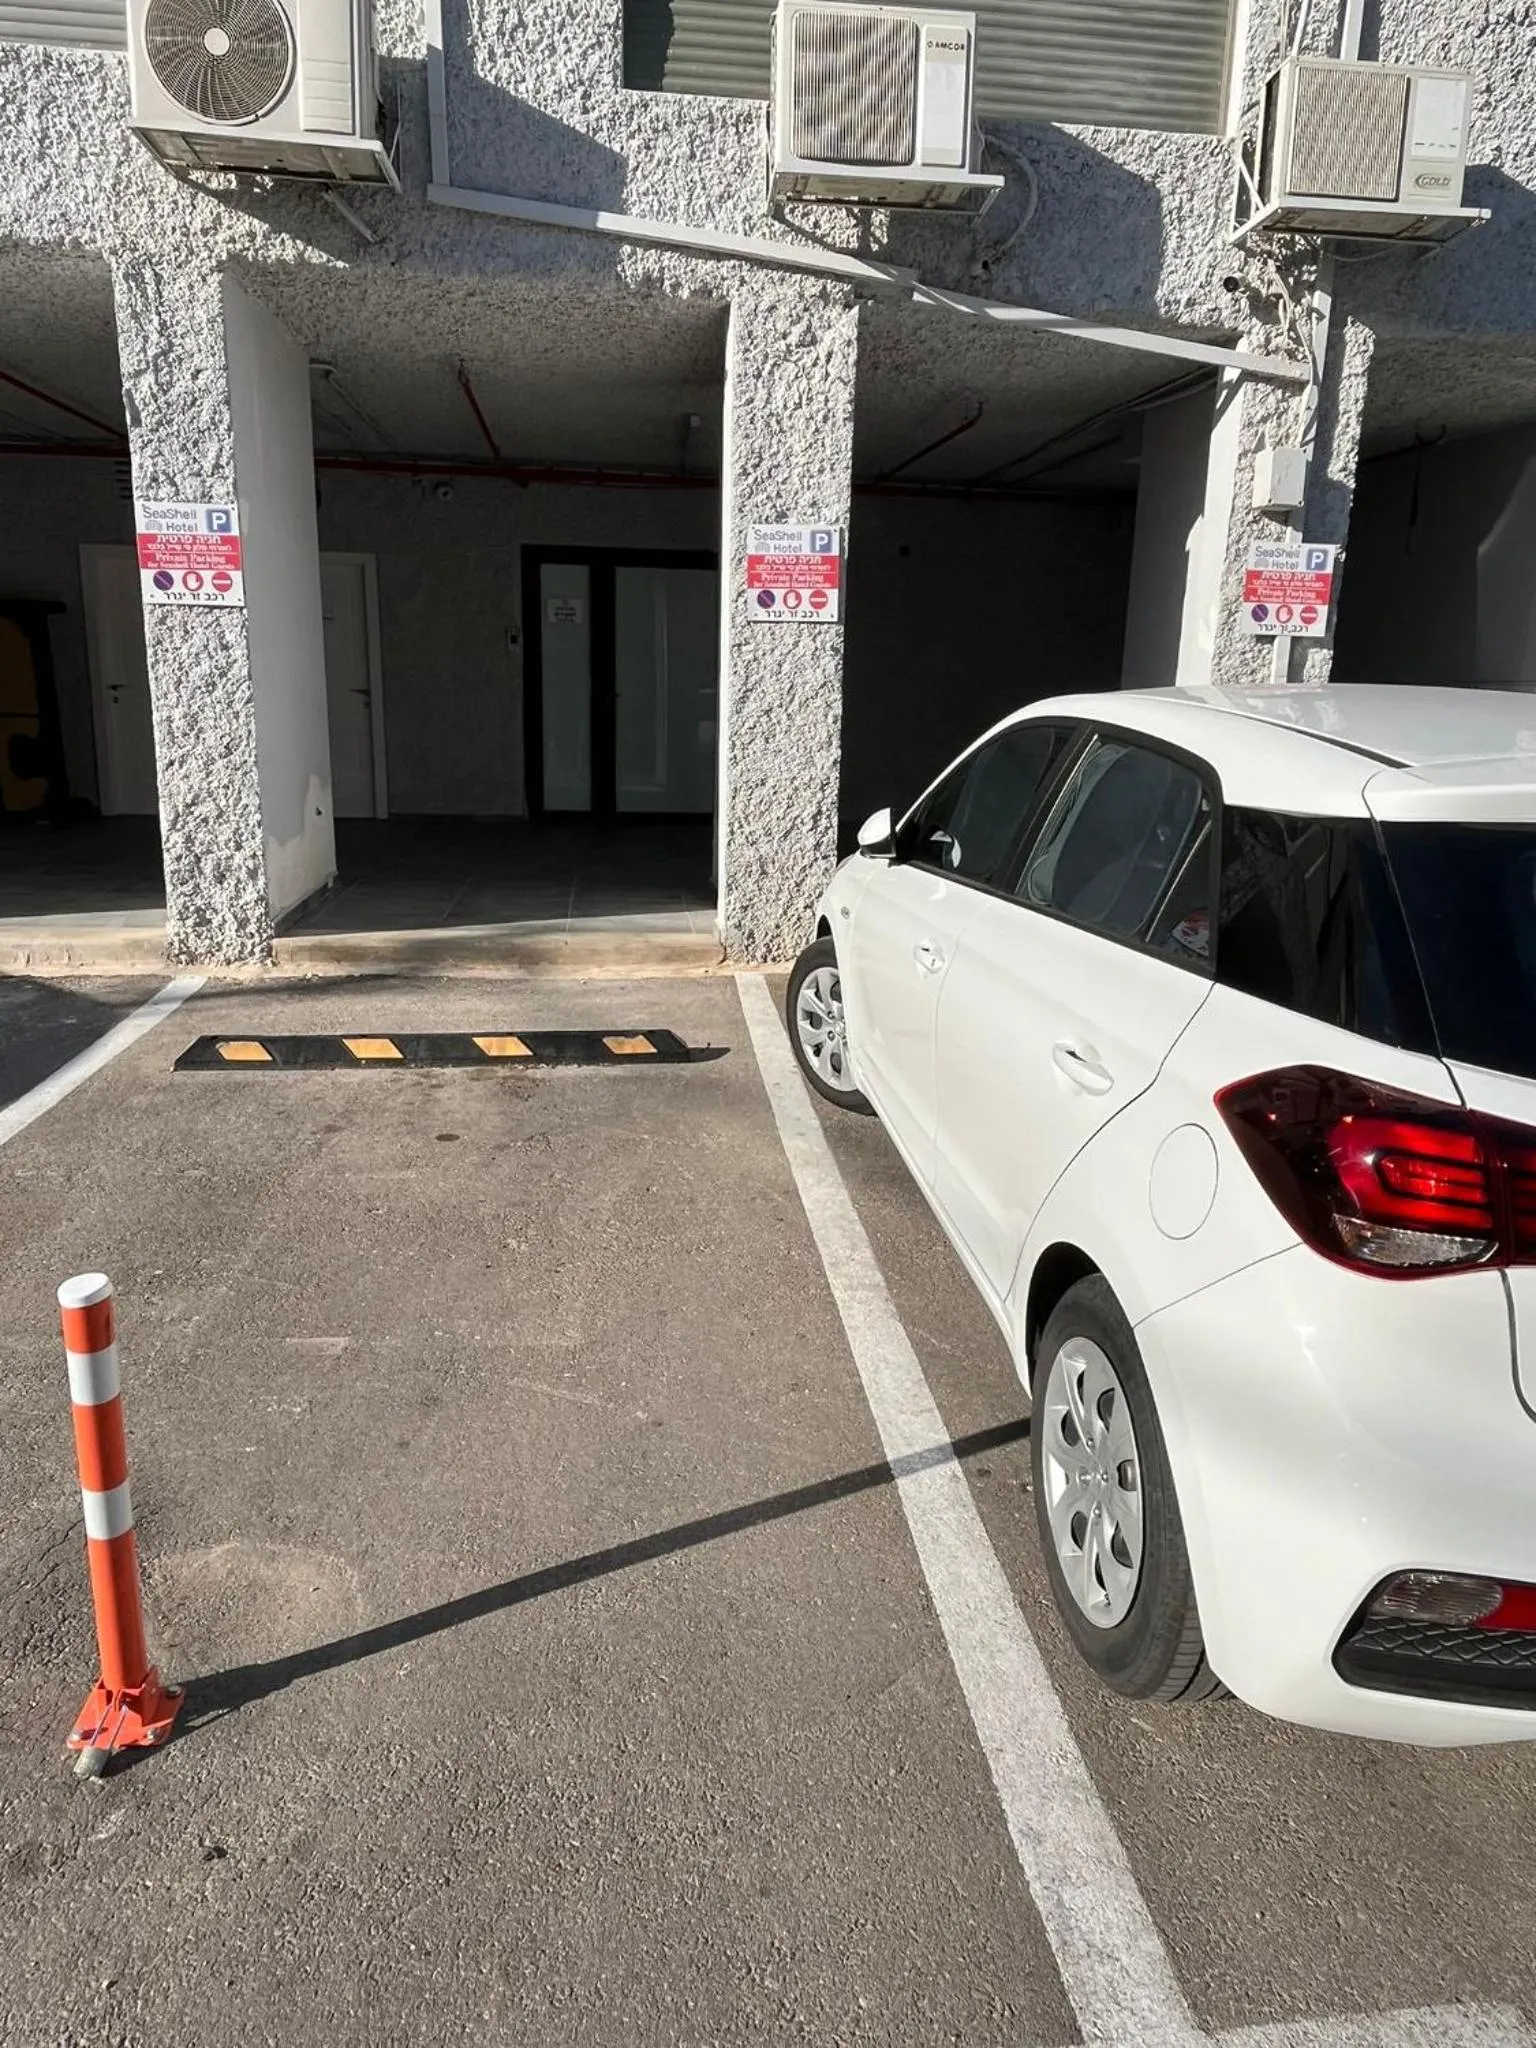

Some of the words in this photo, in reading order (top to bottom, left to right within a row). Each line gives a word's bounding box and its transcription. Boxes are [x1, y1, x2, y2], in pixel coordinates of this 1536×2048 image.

[143, 507, 197, 519] SeaShell
[212, 512, 226, 530] P
[166, 523, 198, 532] Hotel
[754, 529, 802, 540] SeaShell
[815, 533, 829, 551] P
[774, 544, 802, 553] Hotel
[1272, 561, 1299, 570] Hotel
[1311, 552, 1324, 569] P
[204, 592, 225, 601] רכב
